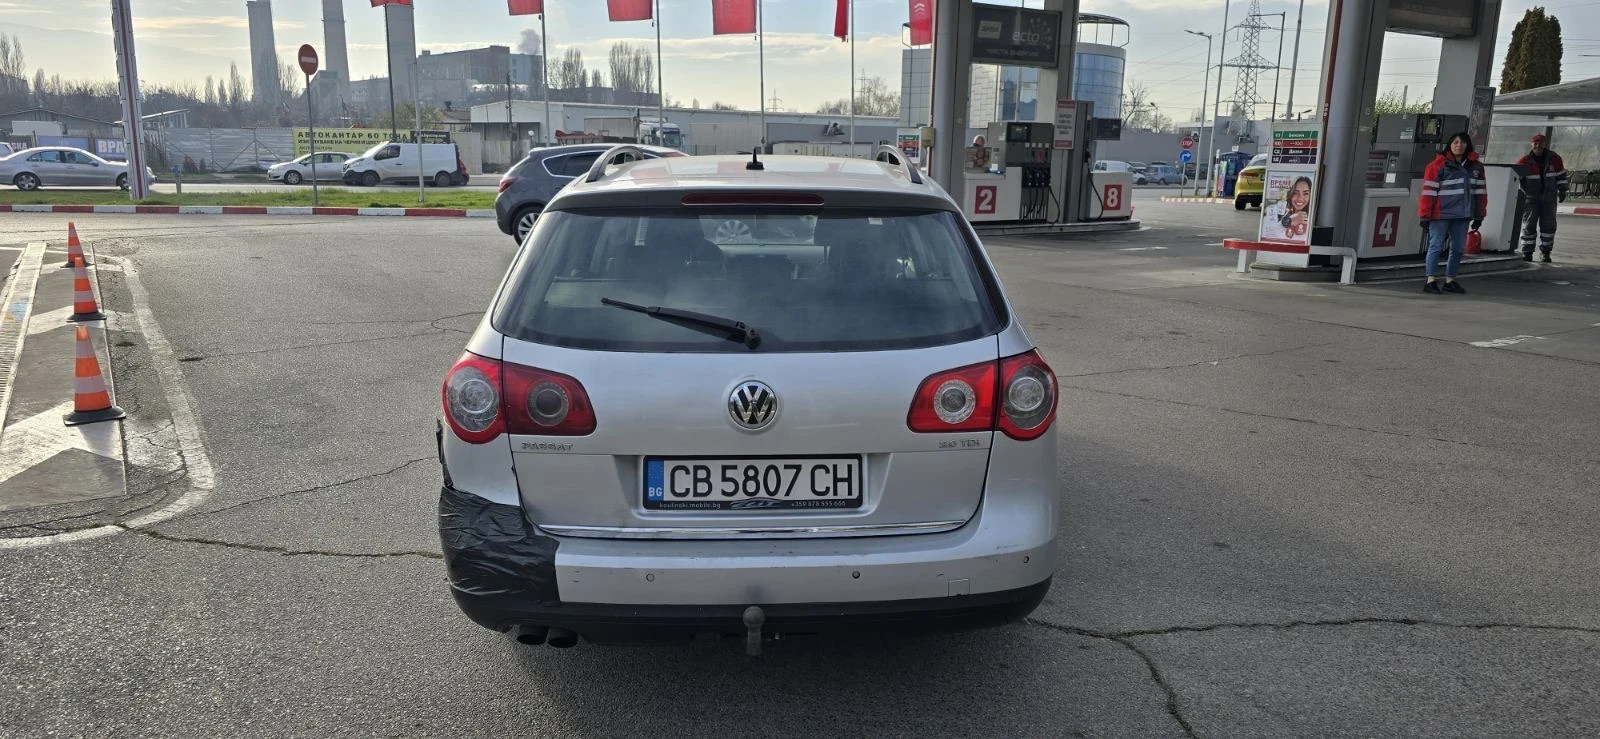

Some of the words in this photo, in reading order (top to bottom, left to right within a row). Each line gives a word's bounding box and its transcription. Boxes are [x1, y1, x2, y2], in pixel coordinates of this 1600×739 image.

[1012, 30, 1040, 42] ecto
[297, 131, 364, 139] АВТОКАНТАР
[978, 189, 992, 211] 2
[1107, 187, 1118, 207] 8
[1378, 212, 1393, 241] 4
[521, 441, 574, 451] PASSAT
[669, 464, 713, 498] CB
[720, 464, 803, 498] 5807
[810, 463, 853, 497] CH
[648, 486, 663, 497] BG
